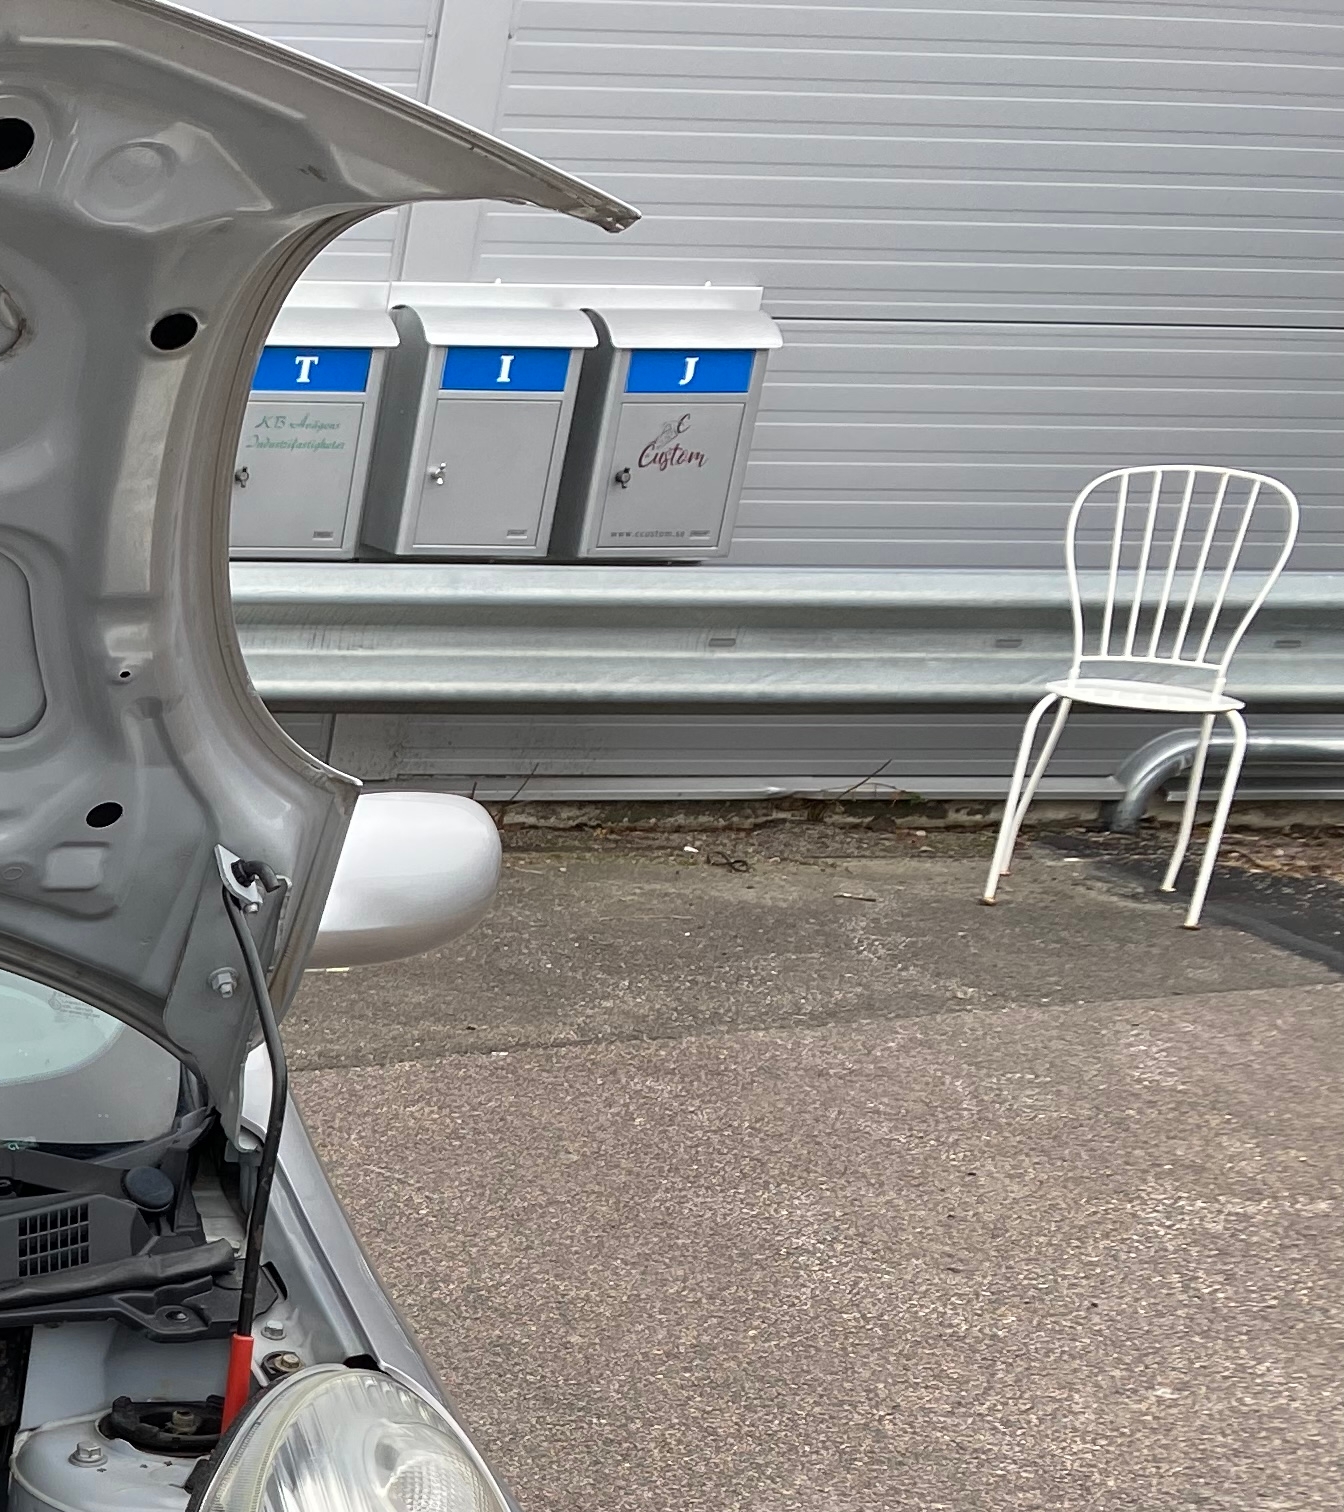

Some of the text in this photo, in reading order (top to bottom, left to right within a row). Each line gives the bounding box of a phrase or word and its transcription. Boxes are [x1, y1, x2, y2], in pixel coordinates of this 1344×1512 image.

[295, 355, 319, 383] T
[496, 355, 515, 383] I
[679, 356, 700, 386] J
[638, 442, 709, 472] Custom
